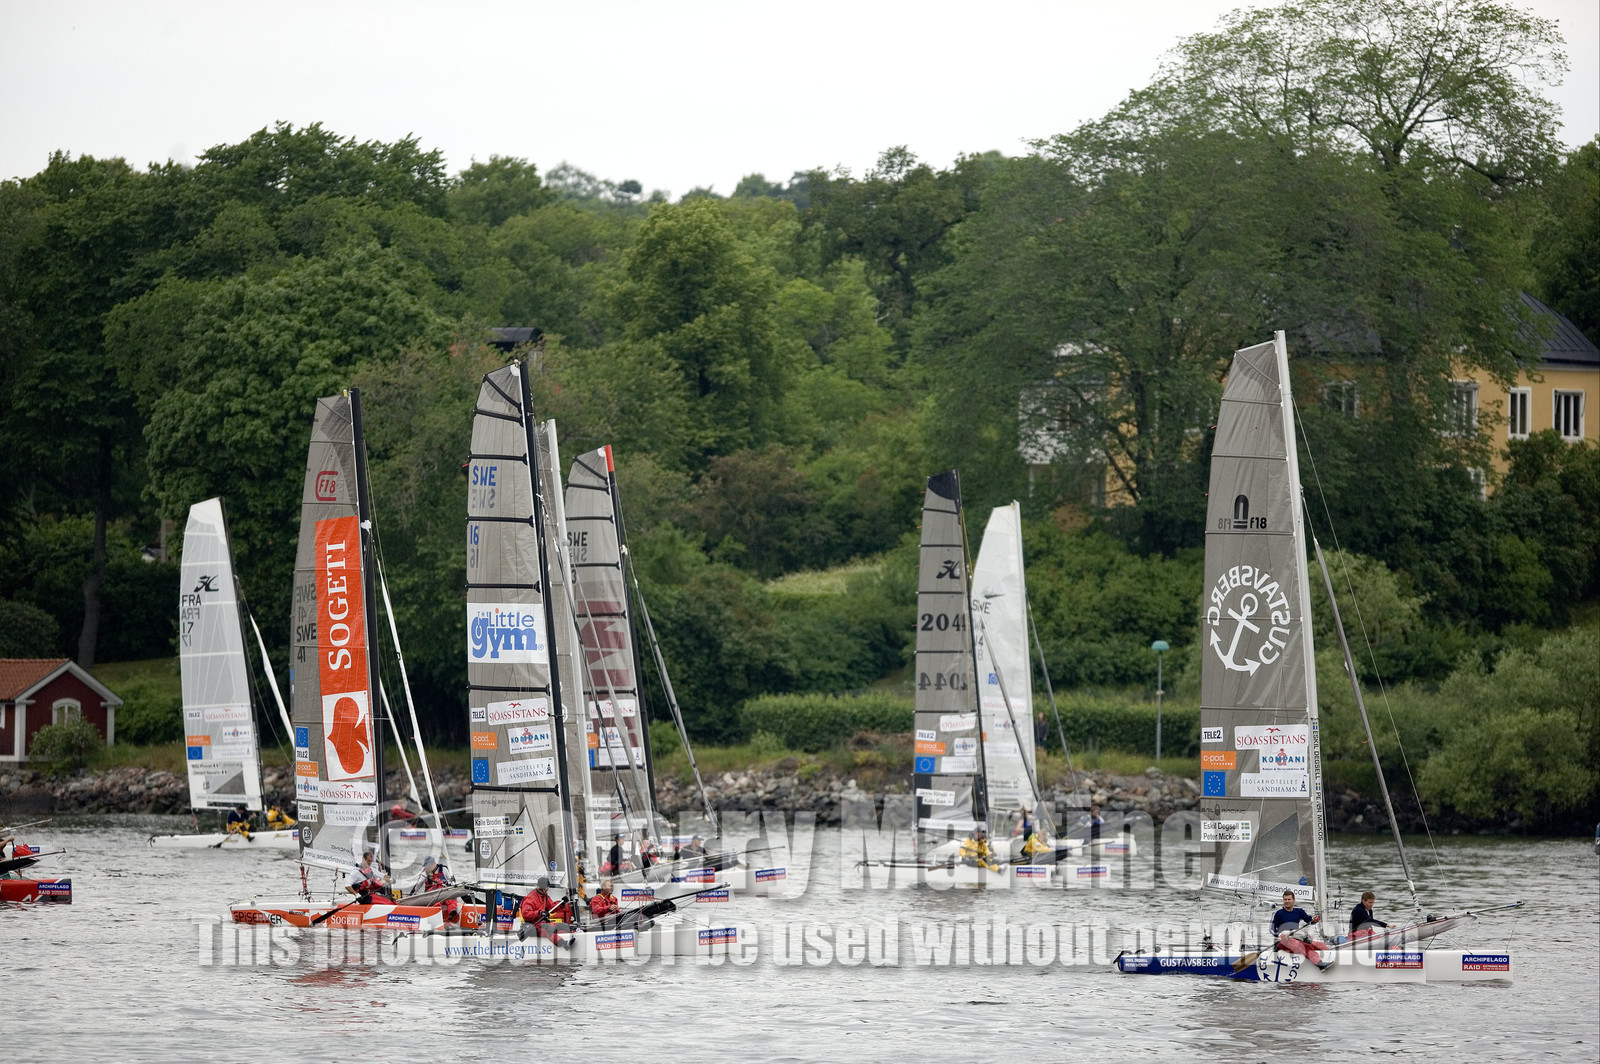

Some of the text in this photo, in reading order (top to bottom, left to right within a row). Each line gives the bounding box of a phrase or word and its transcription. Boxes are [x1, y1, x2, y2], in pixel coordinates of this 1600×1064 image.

[473, 466, 497, 486] SWE
[470, 525, 479, 545] 16
[567, 531, 588, 546] SWE
[181, 595, 202, 607] FRA
[326, 540, 352, 670] SOGETI
[489, 608, 534, 627] Little
[182, 621, 194, 634] 17
[296, 623, 316, 642] SWE
[471, 617, 537, 658] gym
[472, 710, 485, 719] TELE2
[489, 708, 546, 722] SJÖASSISTANS
[511, 733, 549, 744] KOMPANI
[1204, 730, 1221, 739] TELE2
[1237, 734, 1306, 747] SJÖASSISTANS
[510, 771, 544, 779] SANDHAMN
[320, 790, 374, 799] SJÖASSISTANS
[331, 915, 359, 925] SOGETI
[597, 934, 633, 942] ARCHIPELAGO
[444, 940, 552, 959] www.thelittlegym.se
[1160, 958, 1218, 967] GUSTAVSBERG
